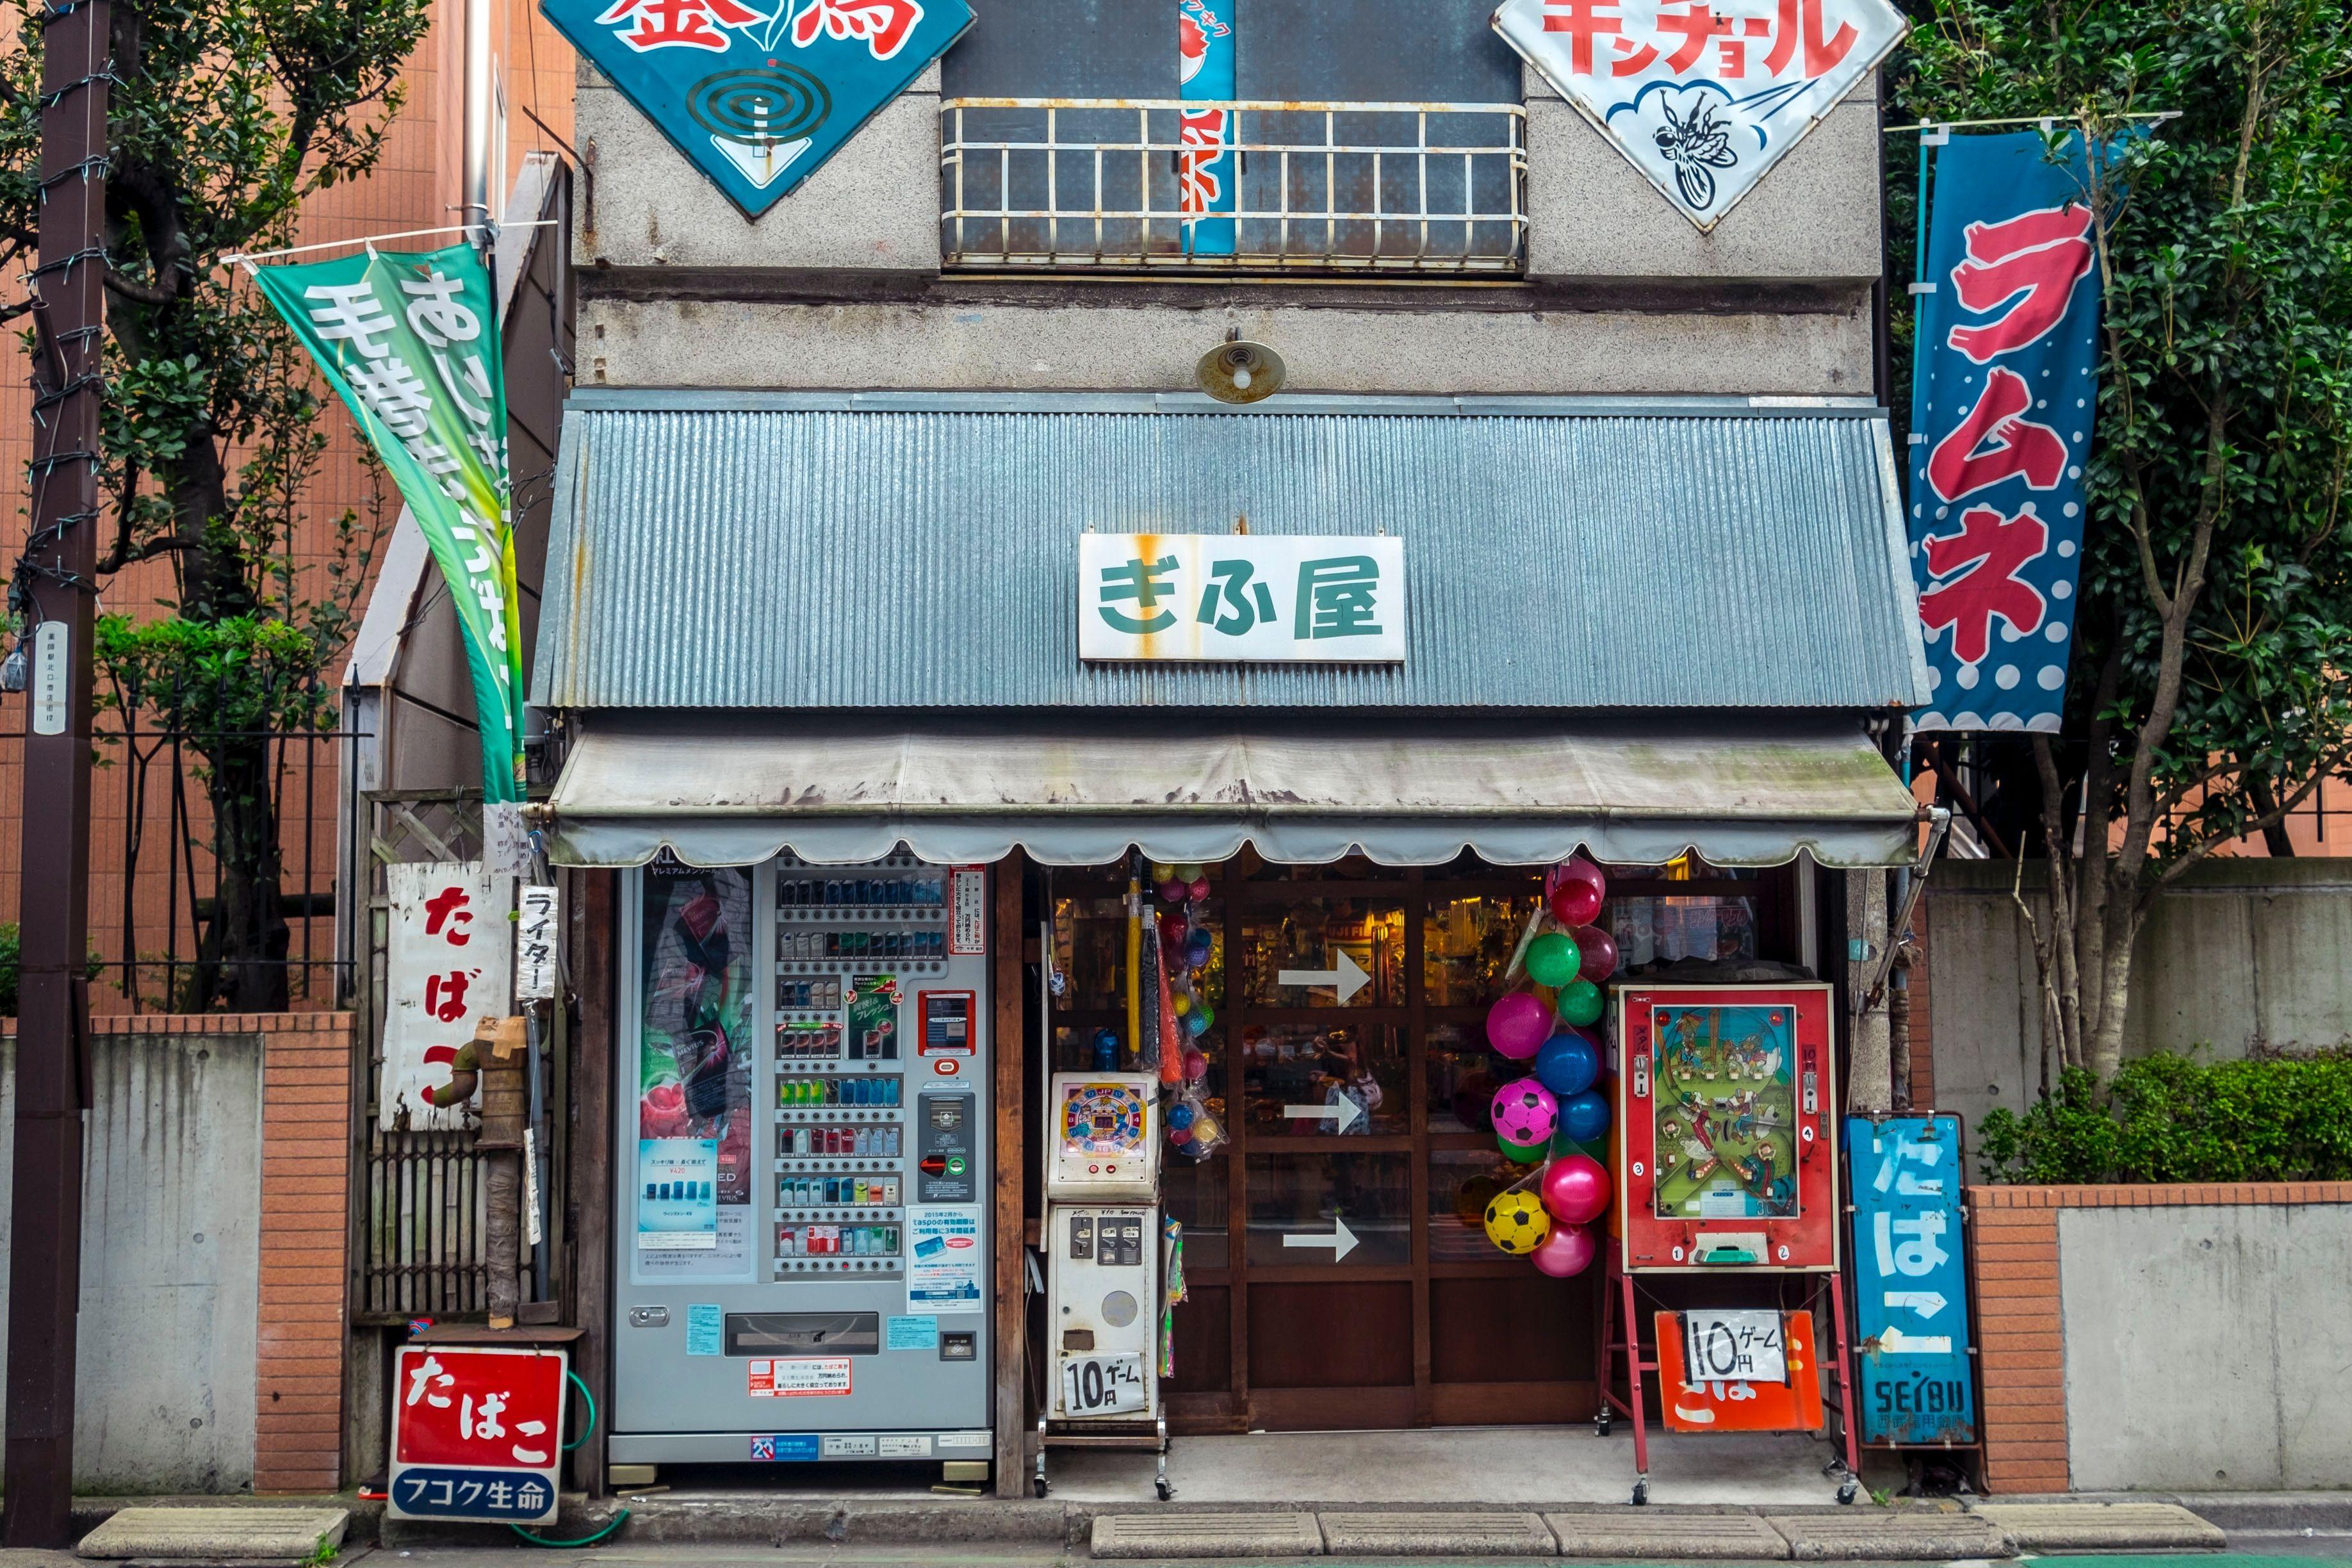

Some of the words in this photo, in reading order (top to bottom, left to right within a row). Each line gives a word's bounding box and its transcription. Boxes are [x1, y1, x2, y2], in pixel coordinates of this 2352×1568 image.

[1542, 0, 1859, 78] キンチョール
[1918, 202, 2096, 665] ラムネ
[1098, 555, 1383, 640] ぎふ屋
[526, 894, 551, 990] ライター
[677, 1040, 704, 1057] MEVIUS
[1804, 1129, 1811, 1138] 4
[1635, 1164, 1642, 1173] 3
[1675, 1249, 1680, 1259] 1
[1781, 1248, 1788, 1257] 2
[1873, 1129, 1952, 1353] たばこ
[1692, 1321, 1738, 1376] 10
[1739, 1326, 1781, 1352] ゲーム
[1737, 1354, 1753, 1373] 円
[1066, 1360, 1105, 1410] 10
[1105, 1359, 1141, 1385] ゲーム
[1104, 1389, 1117, 1406] 円
[1875, 1371, 1964, 1413] SEIBU
[406, 1355, 548, 1464] たばこ
[403, 1478, 546, 1510] フコク生命
